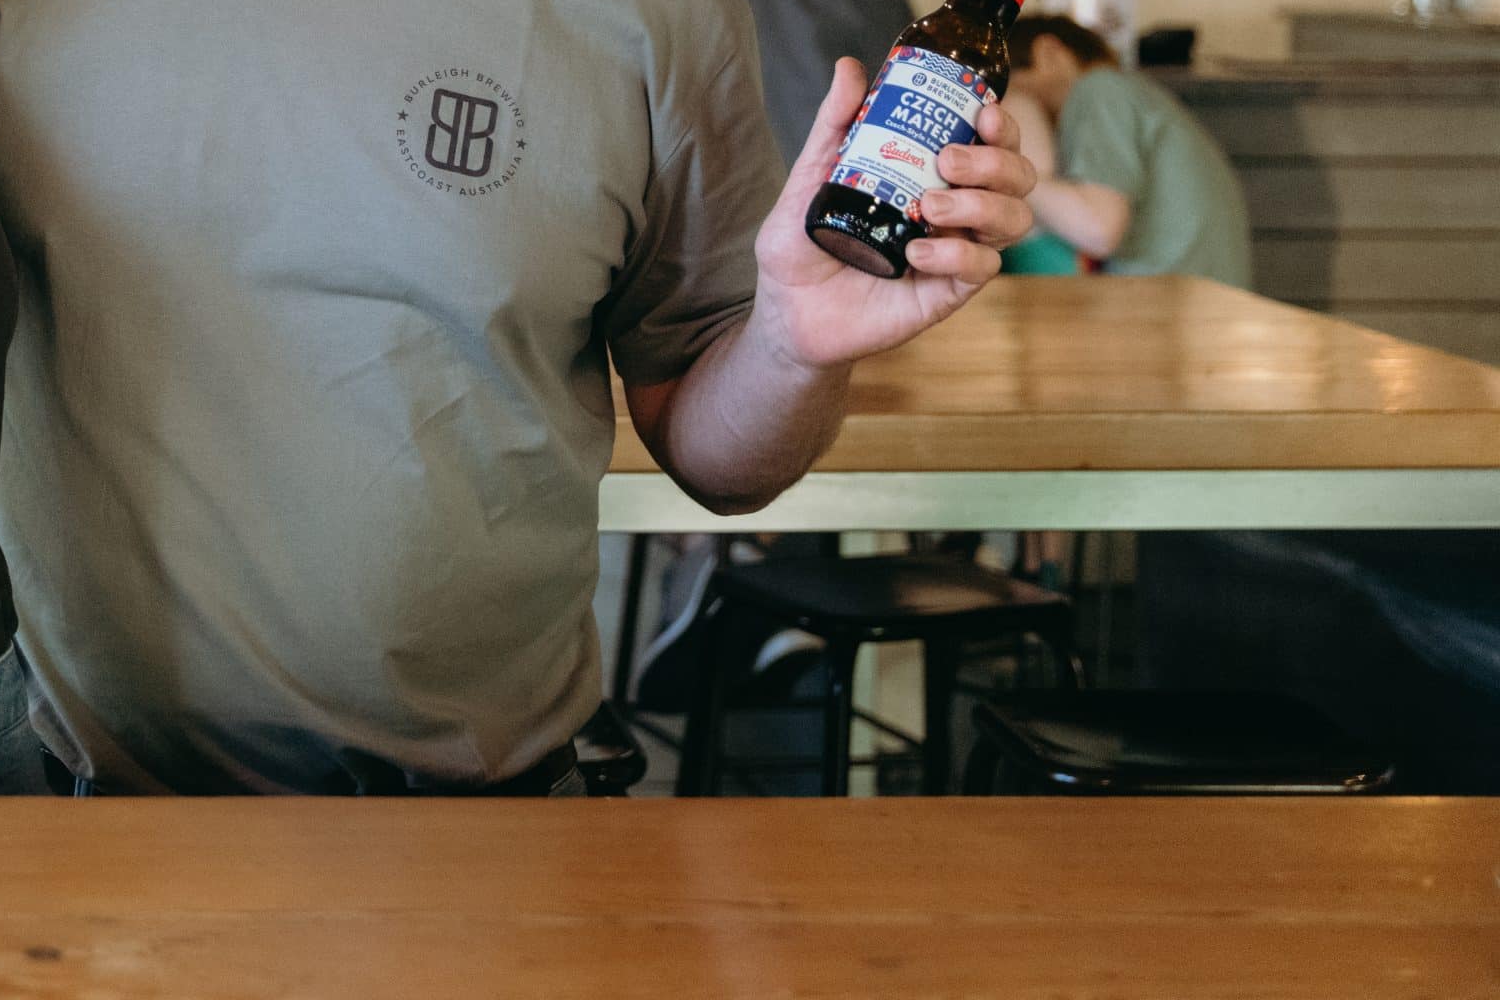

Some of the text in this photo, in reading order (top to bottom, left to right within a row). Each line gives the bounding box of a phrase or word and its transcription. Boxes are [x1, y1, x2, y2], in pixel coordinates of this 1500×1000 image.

[404, 67, 525, 129] BURLEIGH BREWING
[926, 85, 966, 111] BREWING
[930, 77, 969, 104] BURLEIGH
[890, 105, 951, 145] MATES
[900, 91, 959, 131] CZECH
[396, 129, 523, 197] EASTCOAST AUSTRALIA
